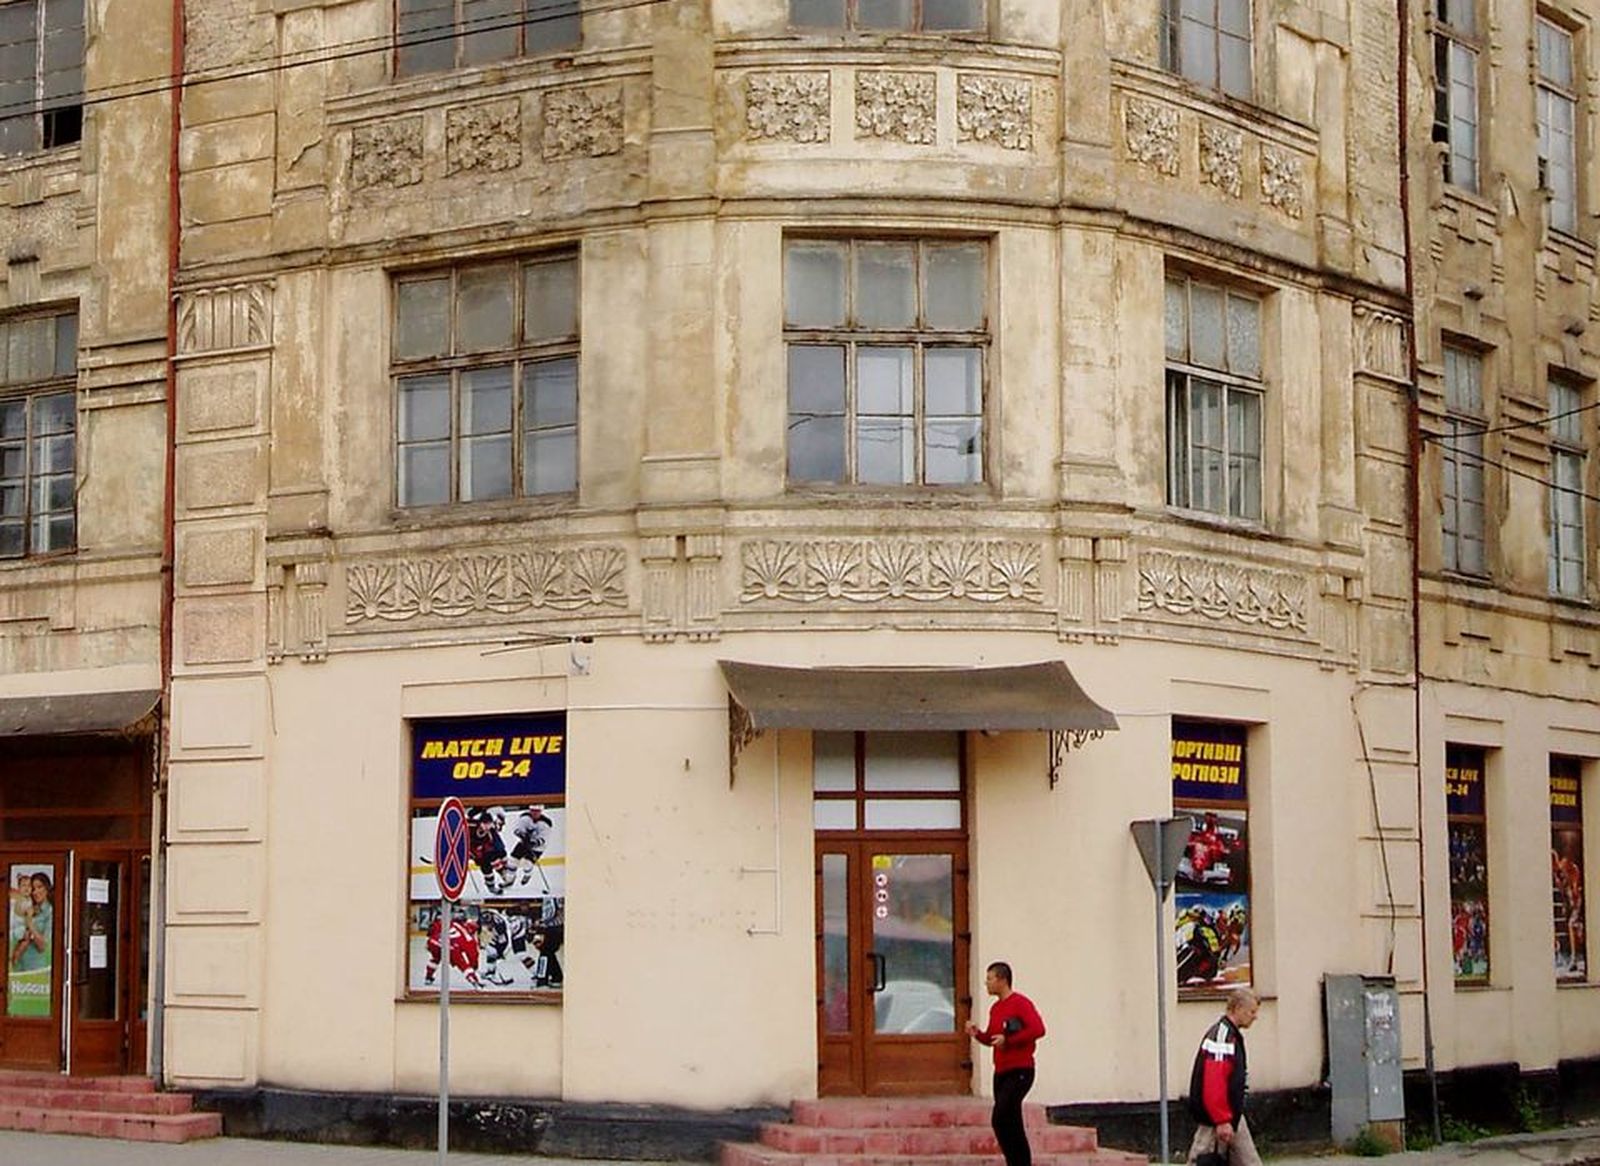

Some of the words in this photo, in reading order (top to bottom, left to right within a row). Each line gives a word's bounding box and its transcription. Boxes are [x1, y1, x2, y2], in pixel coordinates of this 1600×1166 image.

[421, 739, 504, 759] MATCH
[509, 736, 563, 755] LIVE
[452, 759, 531, 779] 00-24
